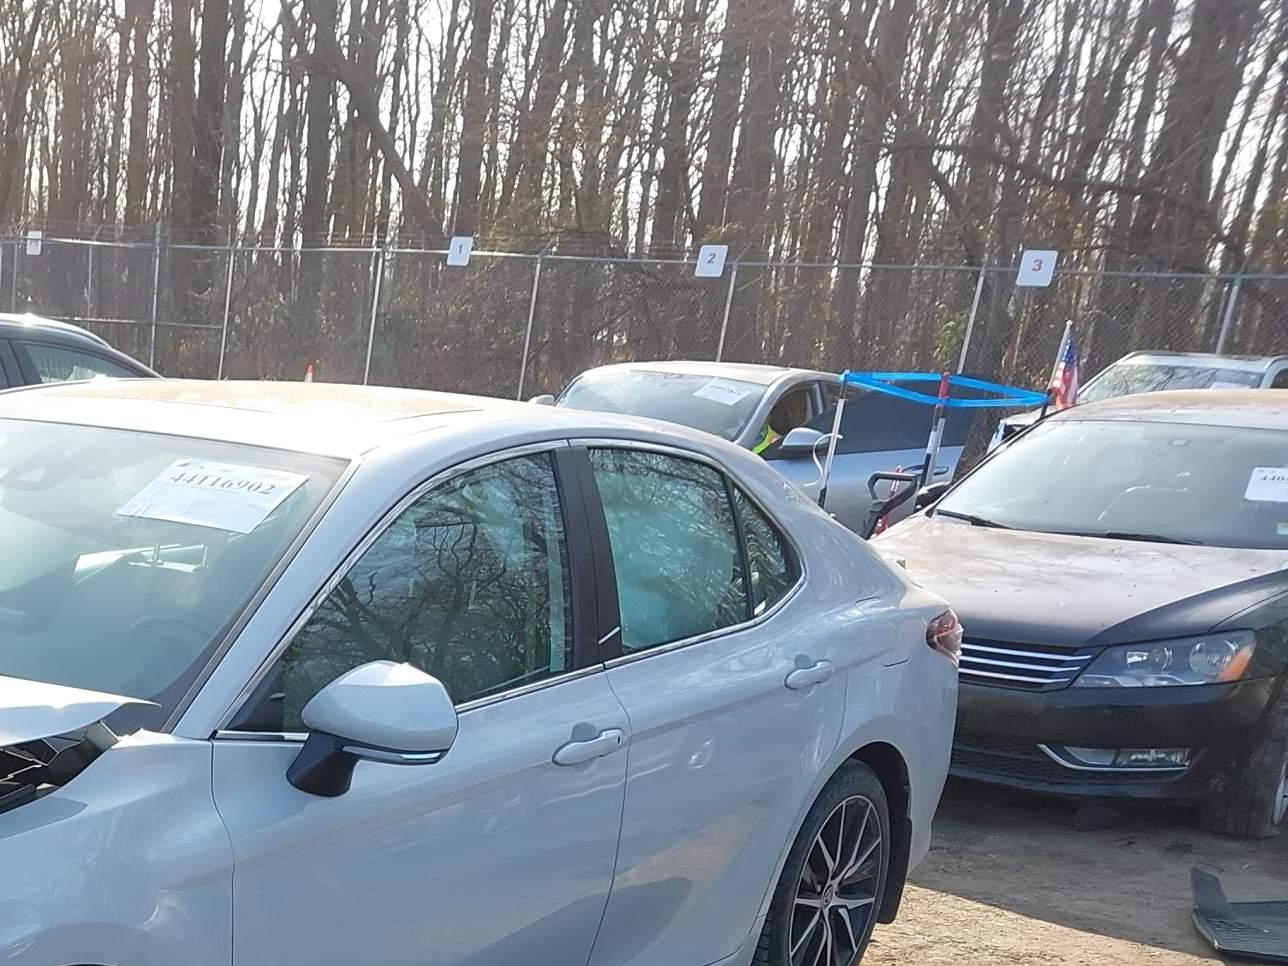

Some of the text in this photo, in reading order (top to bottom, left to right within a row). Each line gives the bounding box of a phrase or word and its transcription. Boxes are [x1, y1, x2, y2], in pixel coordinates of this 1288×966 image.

[706, 252, 716, 264] 2
[1031, 259, 1043, 271] 3
[170, 472, 276, 495] 44116902
